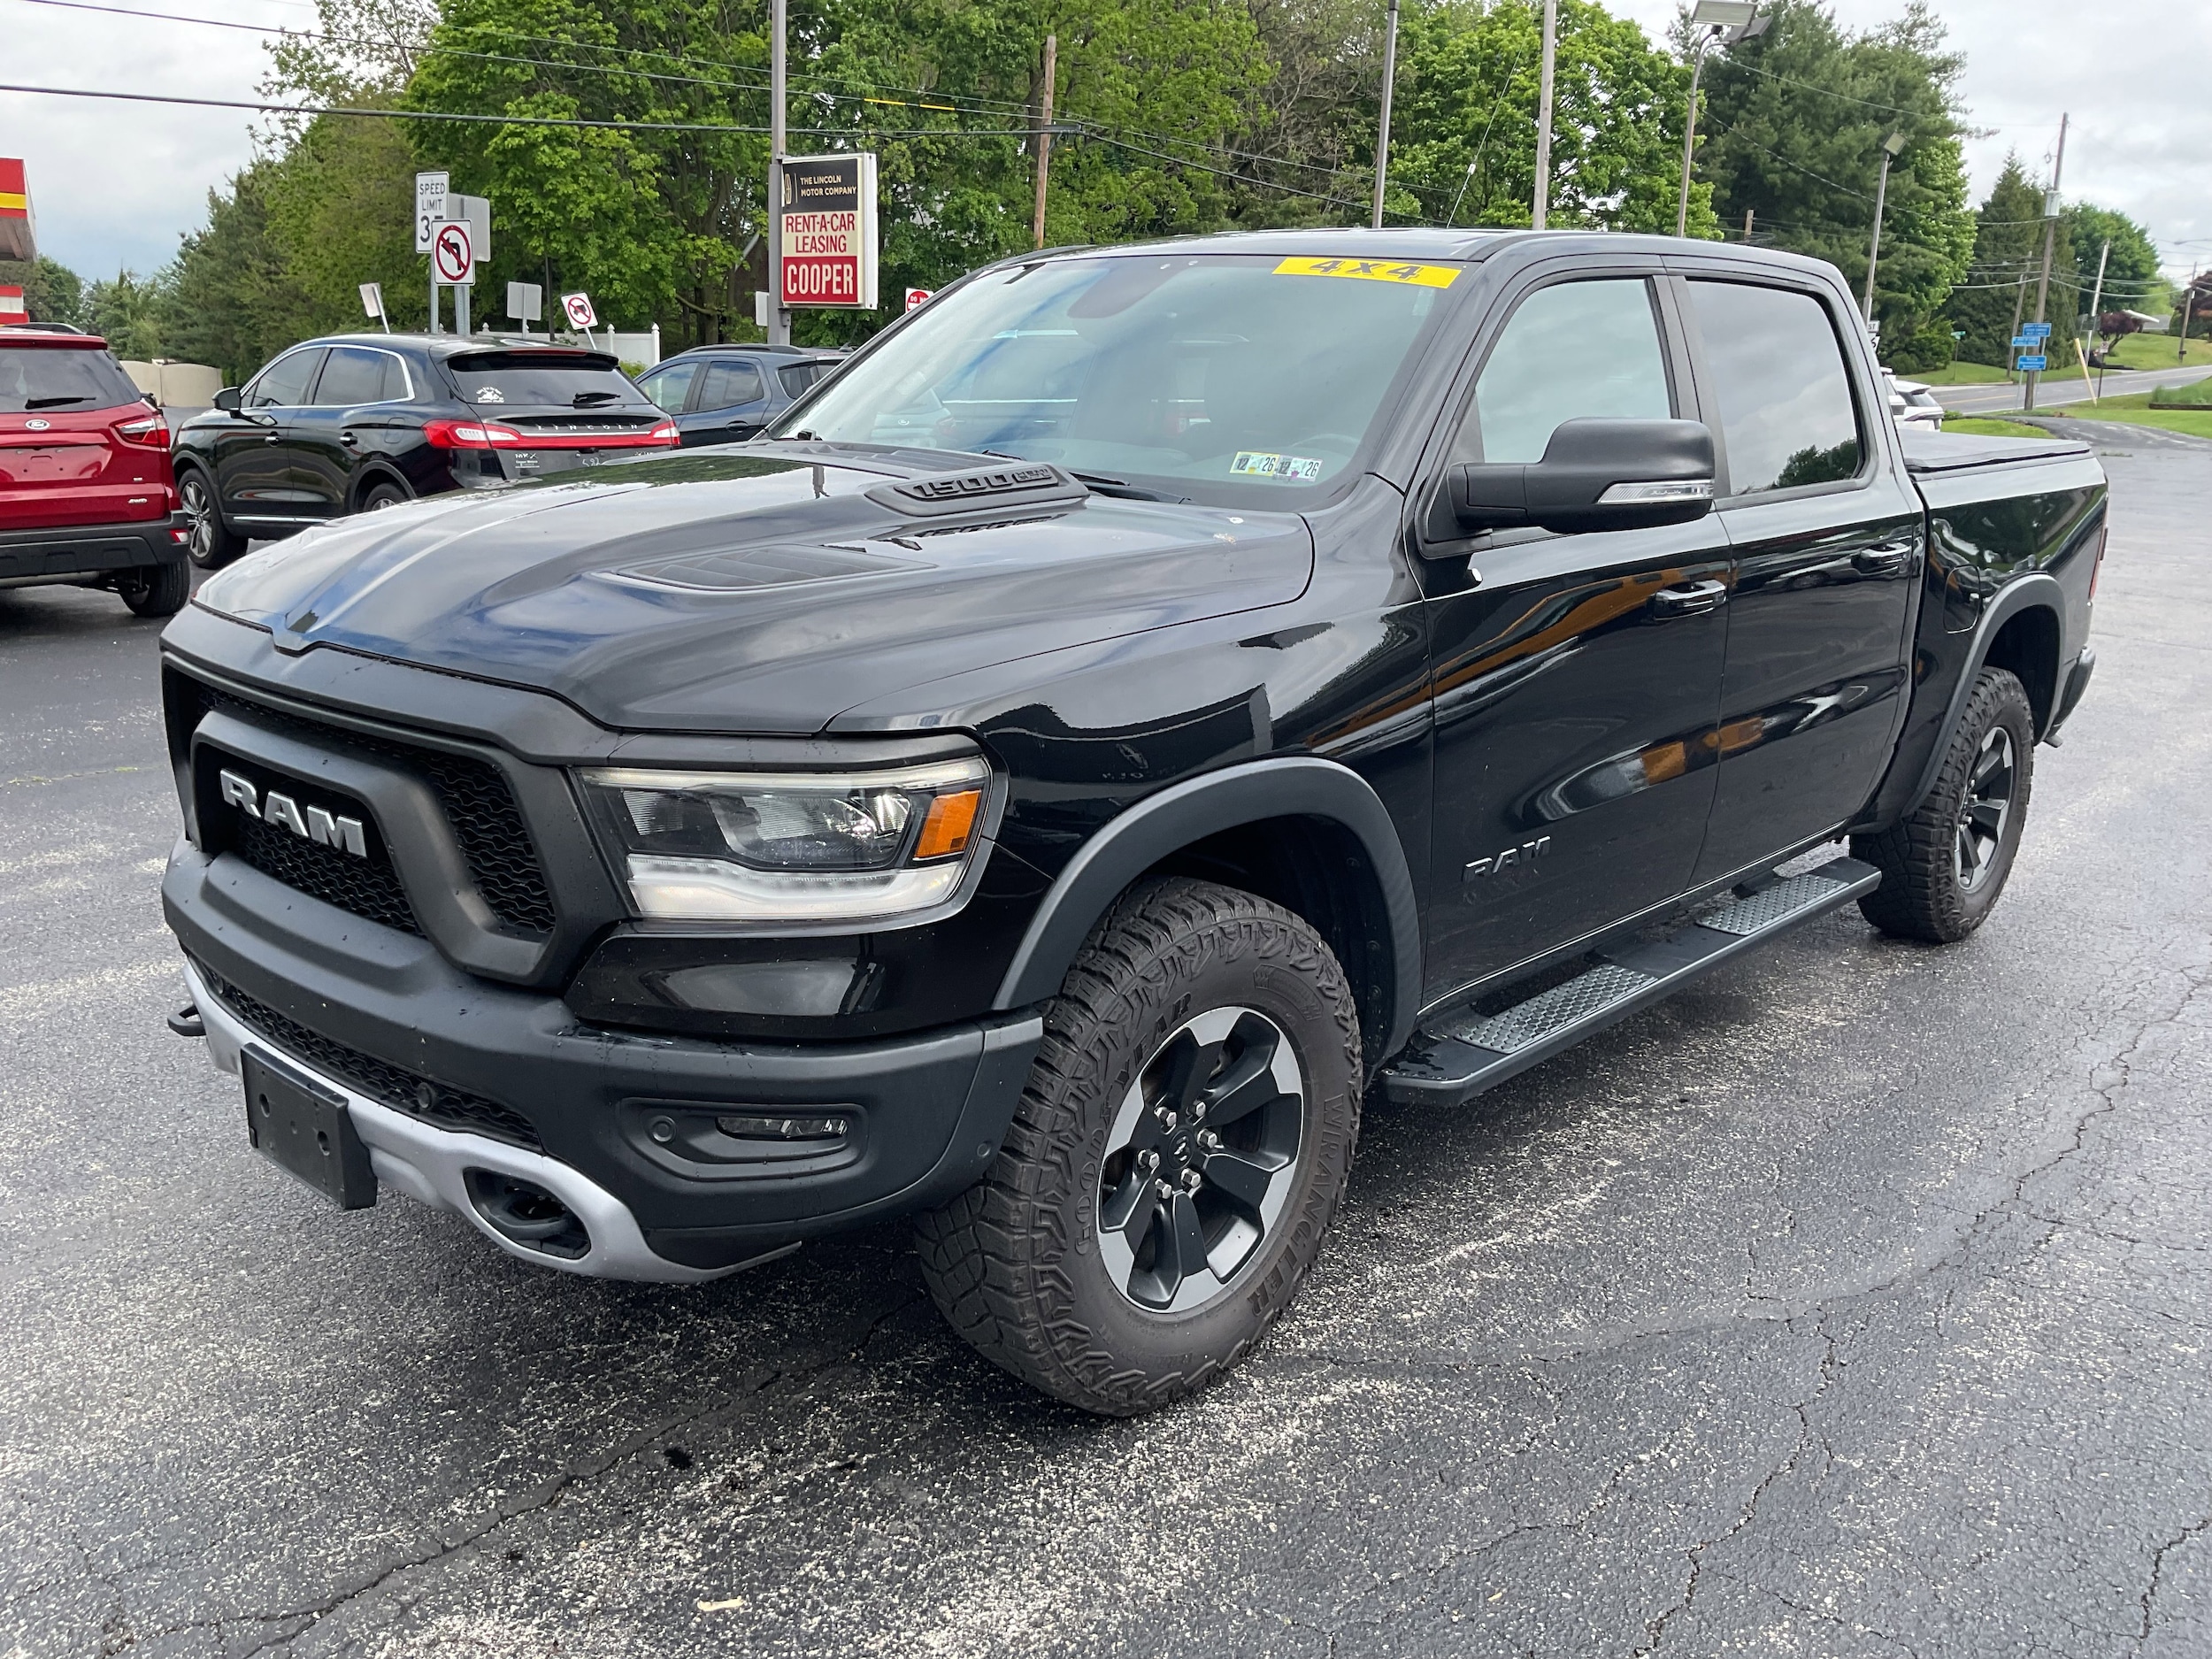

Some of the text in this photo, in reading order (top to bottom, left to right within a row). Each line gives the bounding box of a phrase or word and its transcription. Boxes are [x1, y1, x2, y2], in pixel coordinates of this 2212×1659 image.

[419, 182, 445, 195] SPEED
[813, 175, 841, 184] LINCOLN
[801, 187, 857, 197] MOTOR COMPANY
[422, 199, 442, 211] LIMIT
[420, 215, 443, 242] 3
[786, 213, 856, 234] RENT-A-CAR
[795, 234, 847, 254] LEASING
[787, 264, 854, 295] COOPER
[1237, 457, 1276, 472] 12 26
[1279, 461, 1318, 477] 12 26
[912, 474, 1014, 497] 1500
[220, 768, 368, 858] RAM
[1462, 836, 1550, 883] RAM
